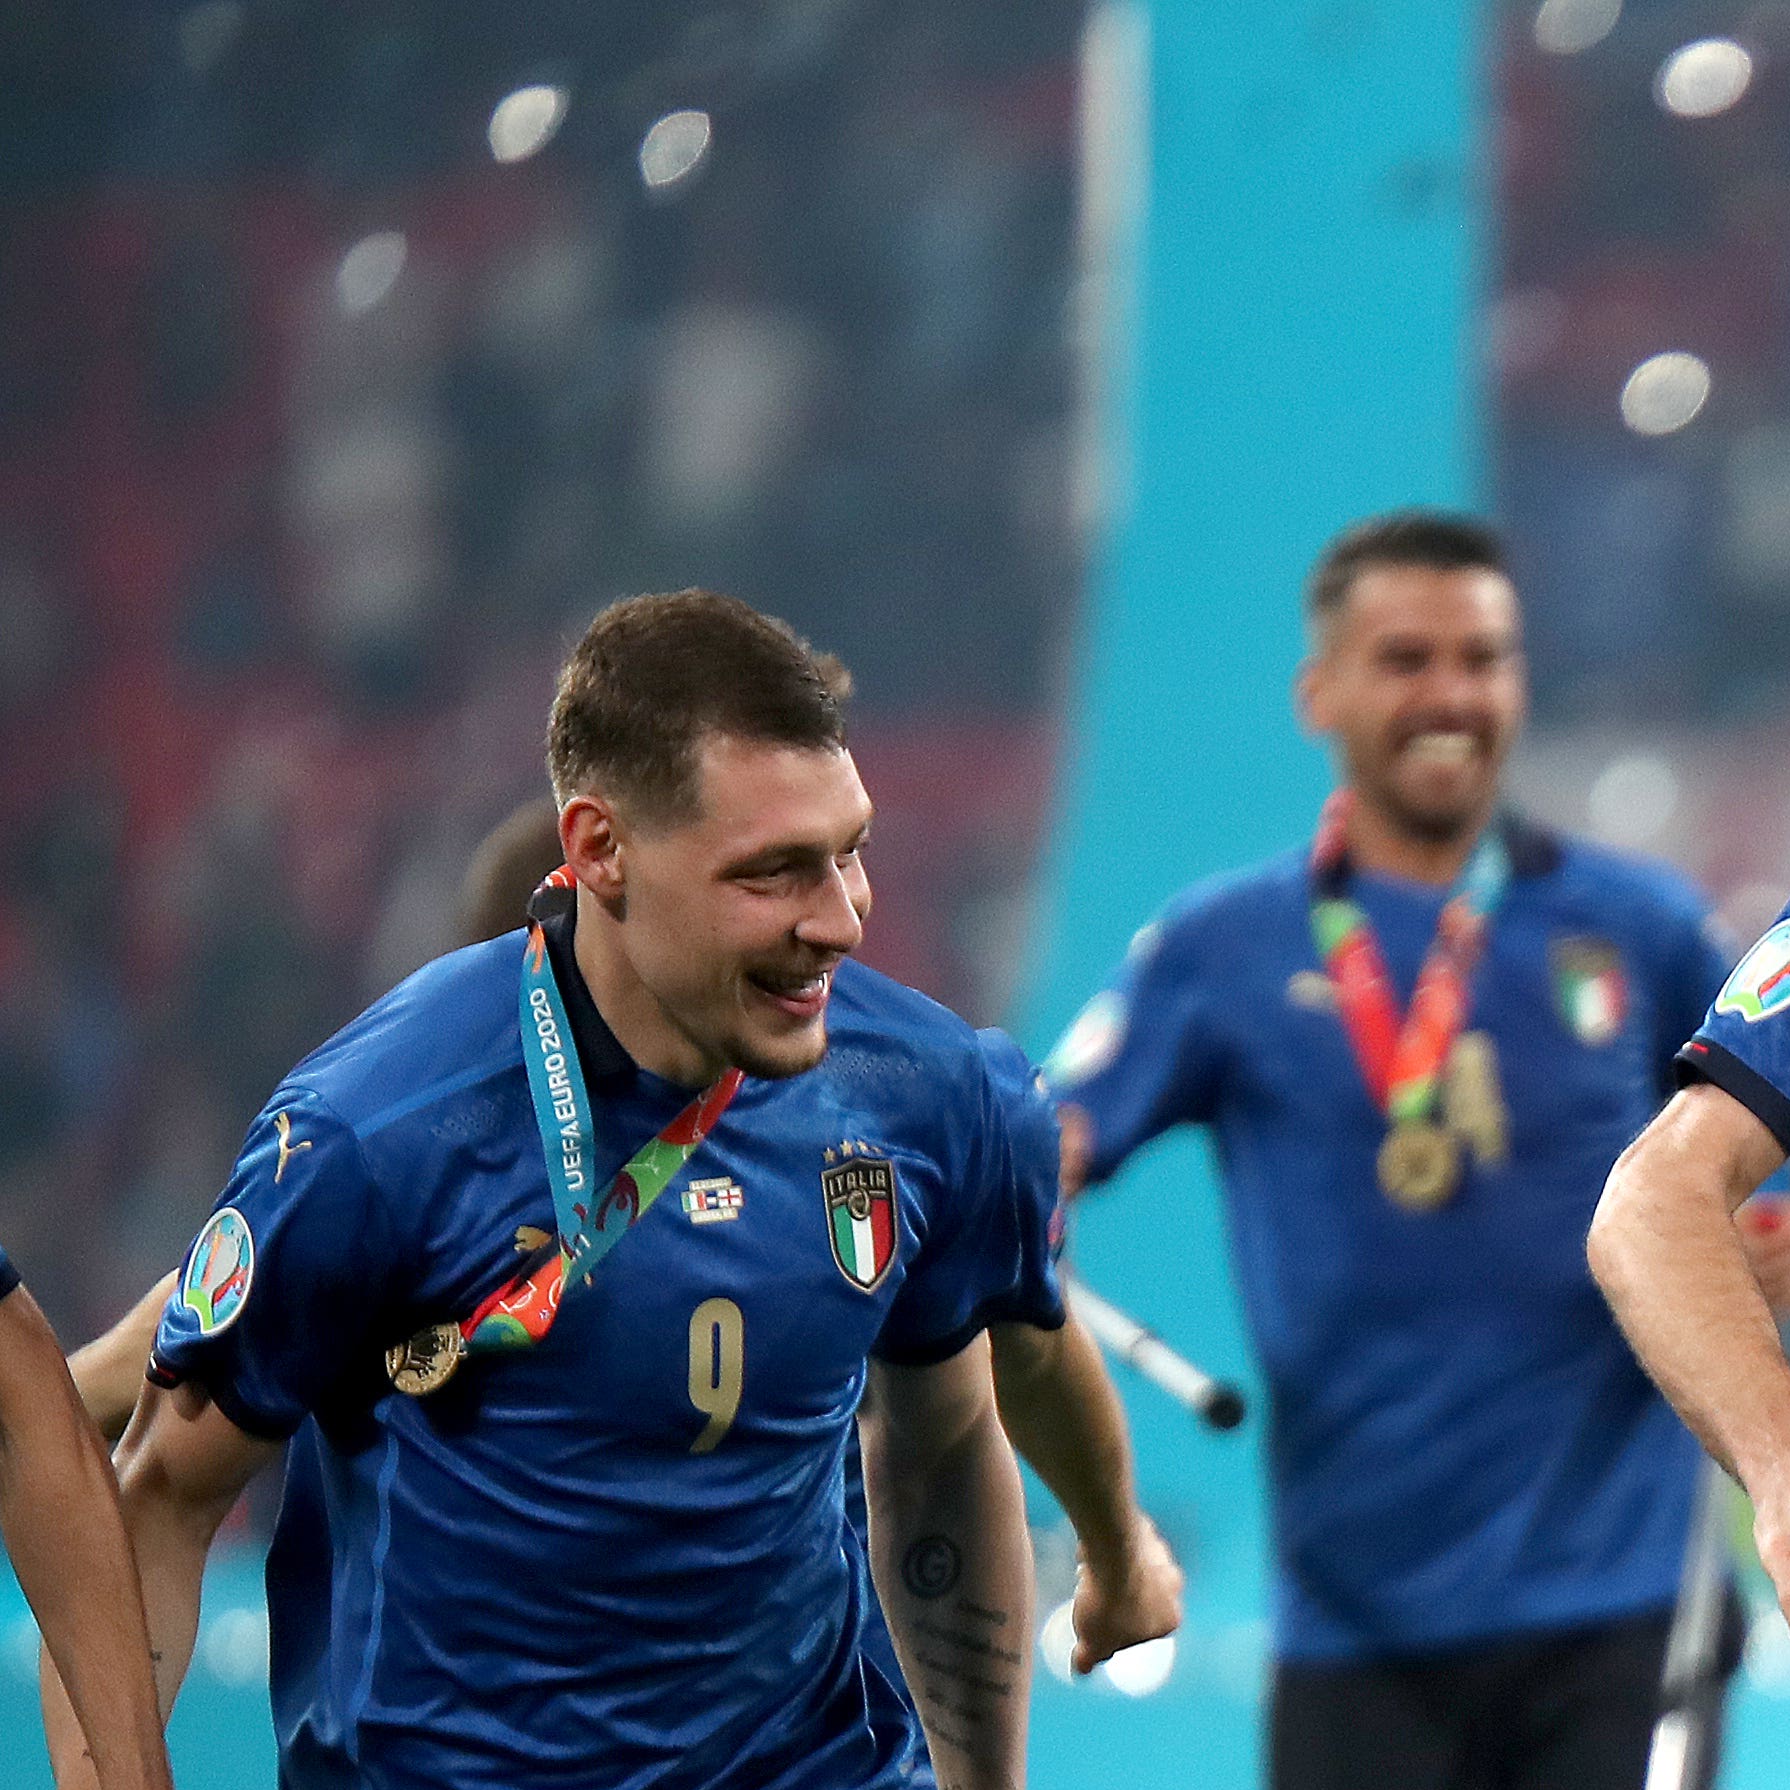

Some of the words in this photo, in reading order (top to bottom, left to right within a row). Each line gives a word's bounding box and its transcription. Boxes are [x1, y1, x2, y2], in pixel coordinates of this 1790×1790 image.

[529, 987, 562, 1051] 2020
[544, 1052, 577, 1122] EURO
[561, 1120, 585, 1192] UEFA
[828, 1169, 887, 1196] ITALIA
[688, 1297, 744, 1453] 9
